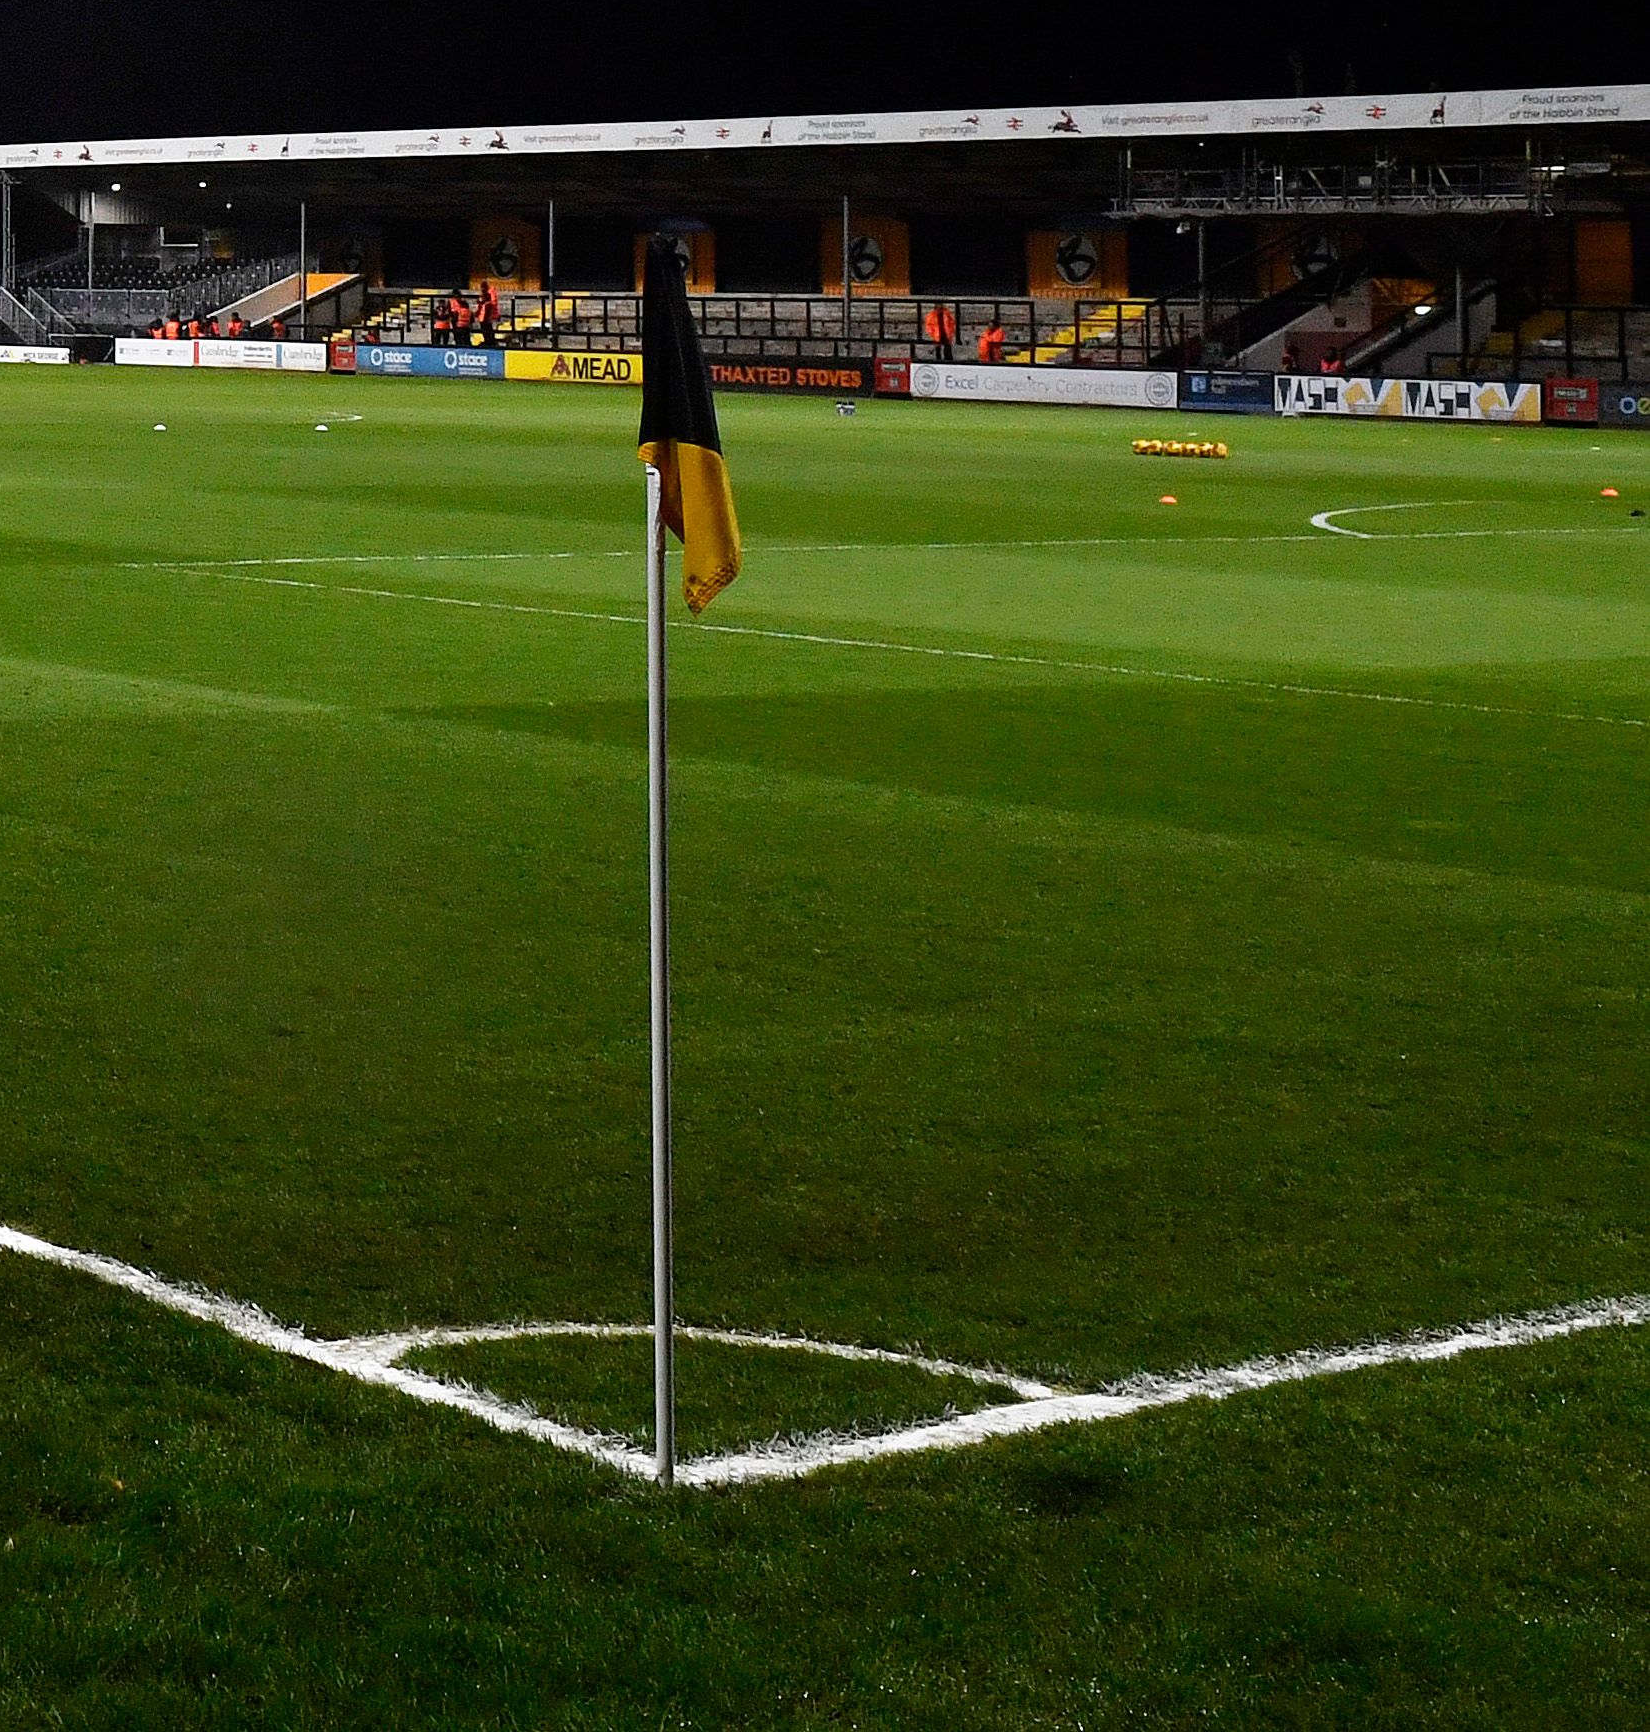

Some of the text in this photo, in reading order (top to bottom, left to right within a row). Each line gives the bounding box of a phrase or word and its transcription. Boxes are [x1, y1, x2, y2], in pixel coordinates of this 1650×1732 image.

[384, 351, 412, 363] stace
[458, 353, 488, 366] stace
[573, 357, 631, 380] MEAD
[711, 365, 862, 388] THAXTED STOVES
[945, 375, 1138, 396] Excel Carpentry Contractors
